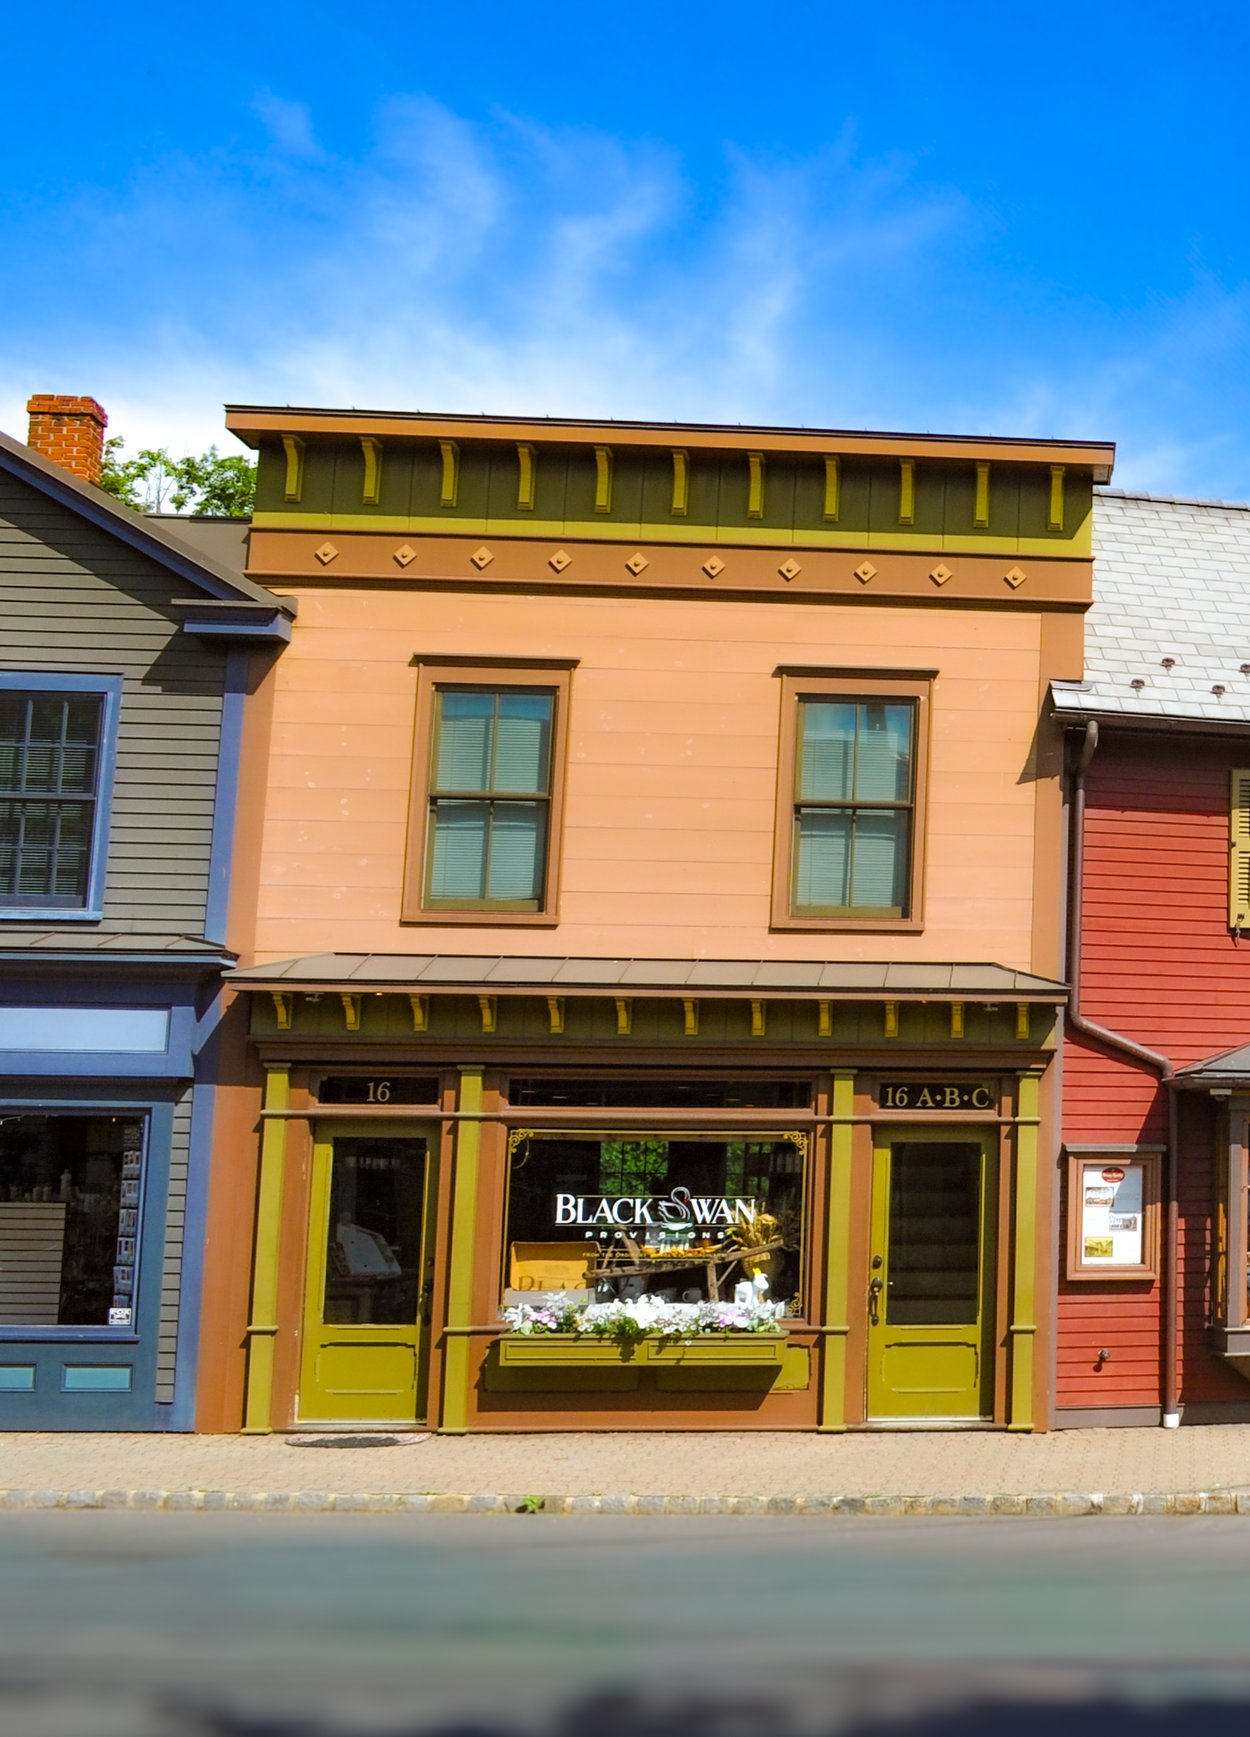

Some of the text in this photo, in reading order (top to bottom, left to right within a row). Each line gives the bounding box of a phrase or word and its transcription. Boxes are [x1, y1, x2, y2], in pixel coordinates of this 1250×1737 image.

[366, 1081, 390, 1103] 16
[885, 1086, 908, 1107] 16
[555, 1193, 653, 1224] BLACK
[584, 1230, 725, 1240] PROVISIONS
